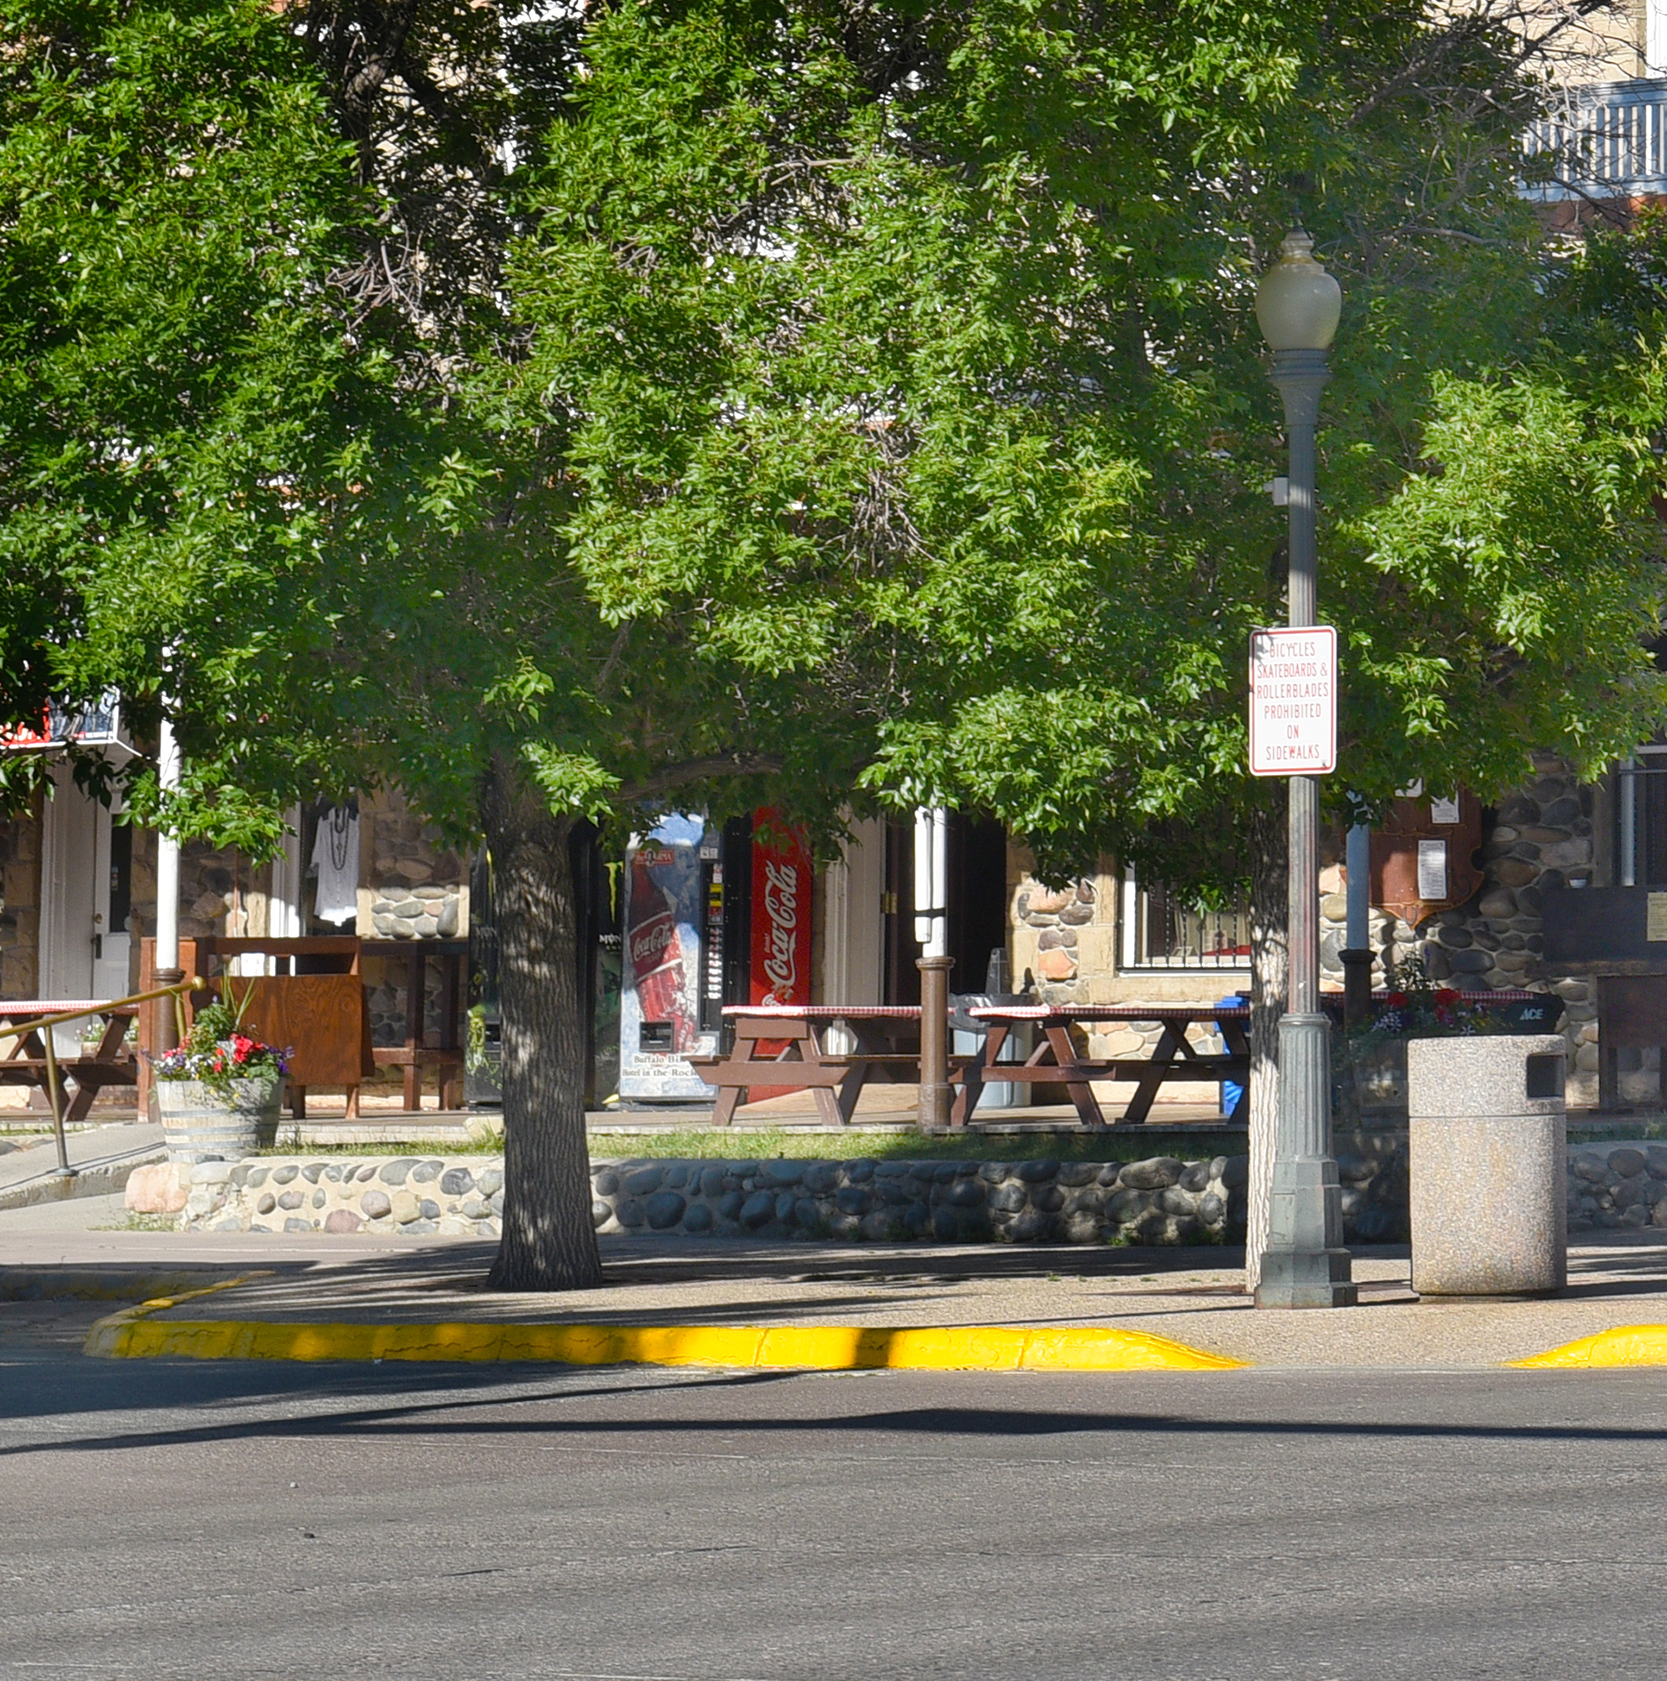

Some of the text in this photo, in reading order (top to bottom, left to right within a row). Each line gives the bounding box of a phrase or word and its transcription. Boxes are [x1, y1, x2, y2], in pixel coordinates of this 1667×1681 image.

[1269, 641, 1316, 658] BICYCLES
[1257, 662, 1328, 679] SKATEBOARDS &
[1257, 682, 1329, 699] ROLLERBLADES
[1264, 703, 1322, 719] PROHIBITED
[1287, 724, 1299, 739] ON
[1266, 745, 1320, 761] SIDEWALKS
[1520, 1008, 1544, 1021] ACE
[622, 1068, 641, 1076] Hotel
[642, 1068, 651, 1076] in
[653, 1068, 668, 1076] the
